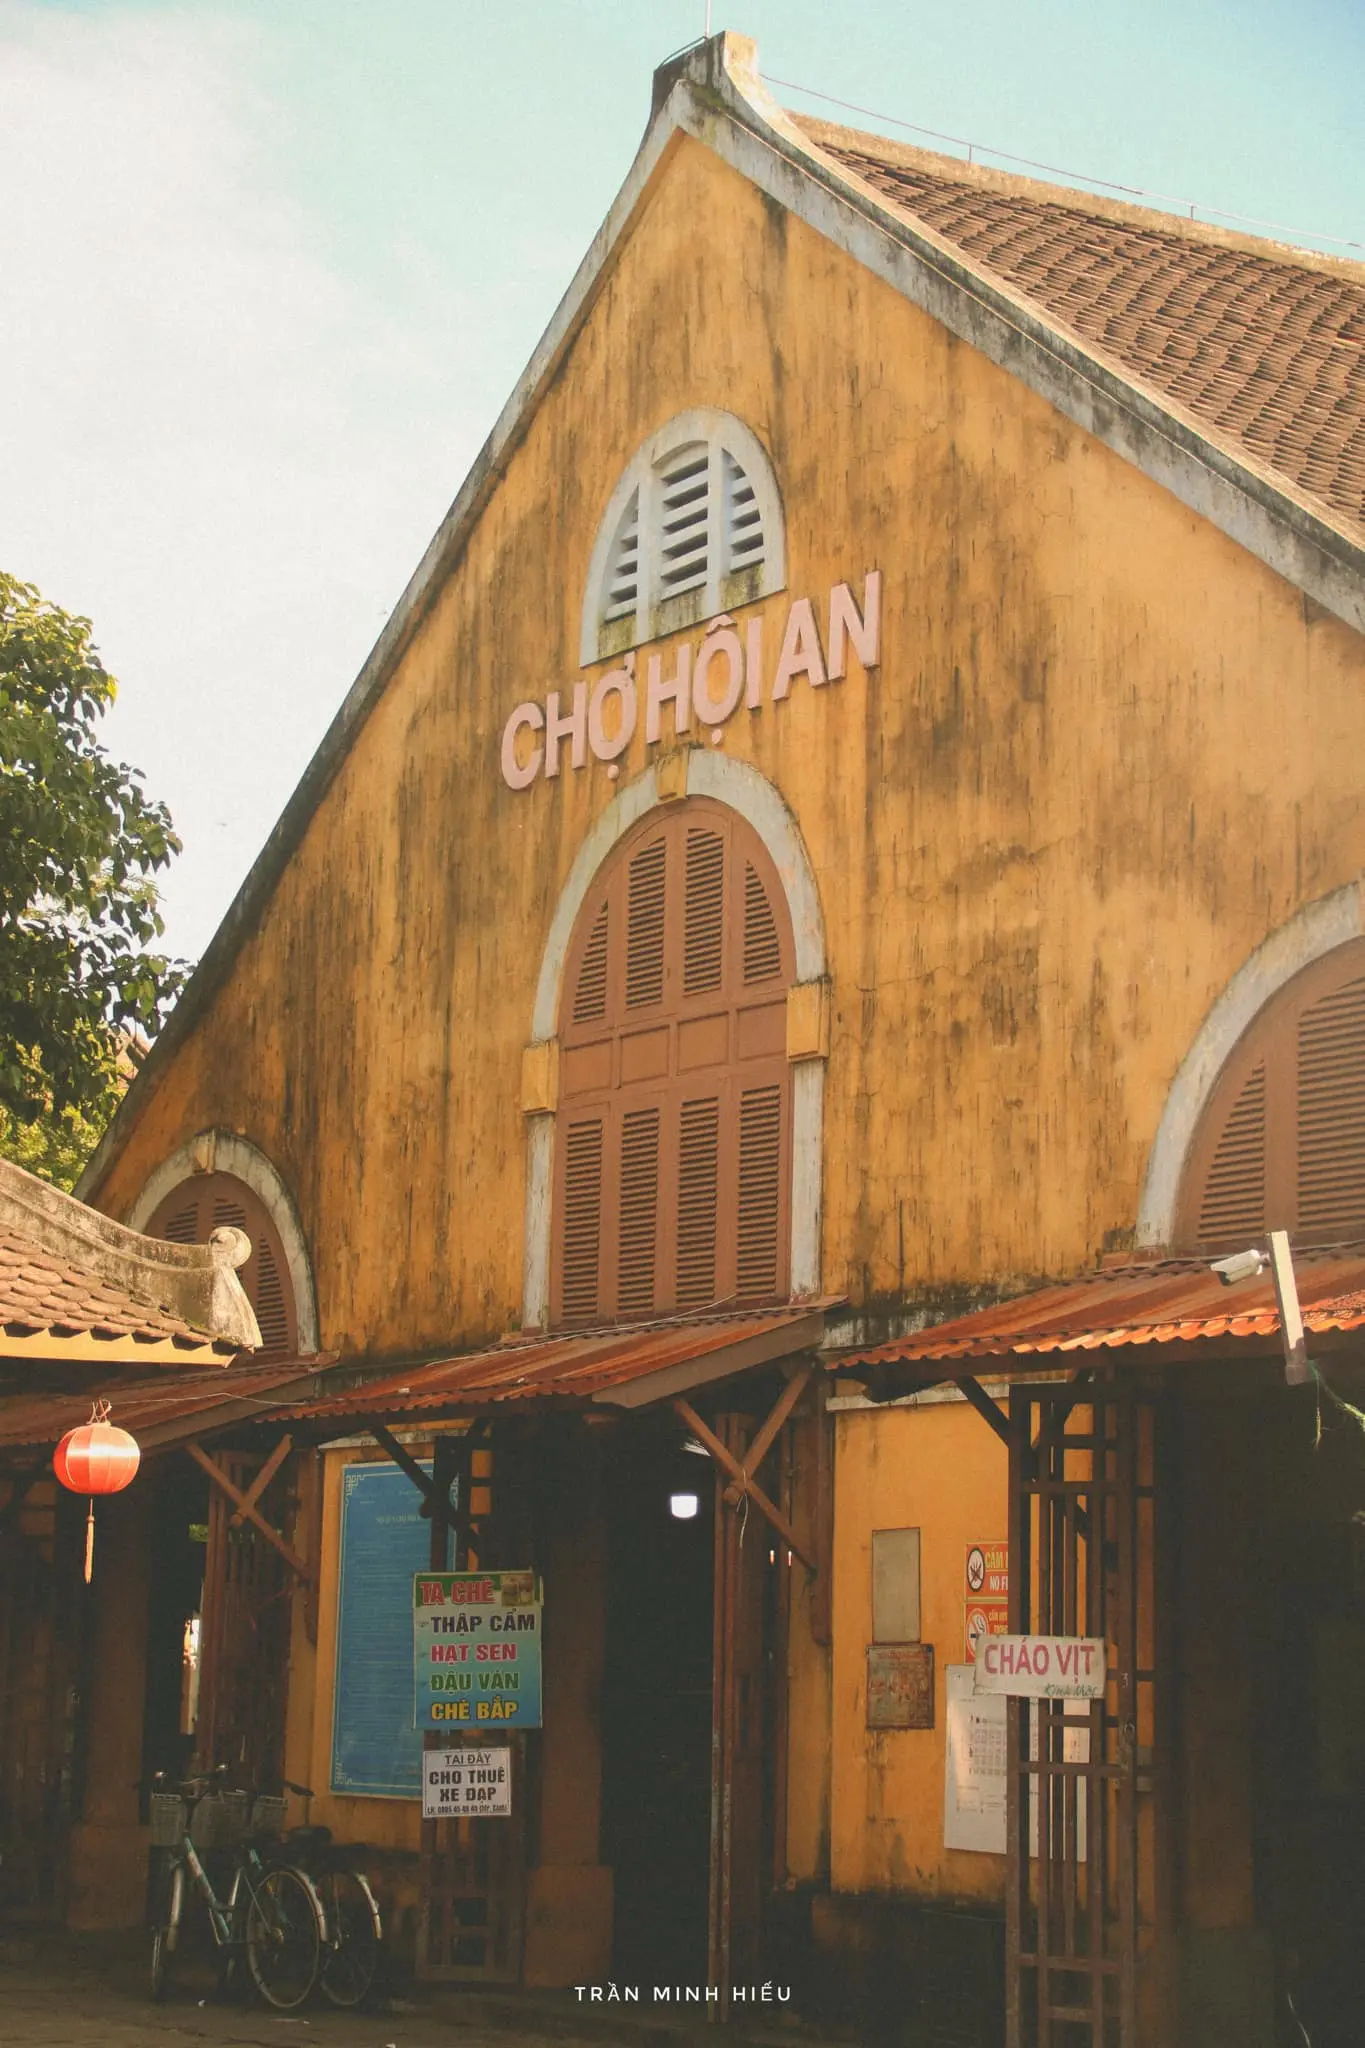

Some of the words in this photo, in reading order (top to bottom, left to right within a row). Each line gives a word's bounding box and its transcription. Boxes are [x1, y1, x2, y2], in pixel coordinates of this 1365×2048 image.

[501, 651, 637, 790] CHỢ
[646, 614, 763, 745] HỘI
[771, 569, 882, 702] AN
[430, 1612, 482, 1636] THẬP
[490, 1608, 536, 1632] CẨM
[431, 1643, 470, 1665] HẠT
[475, 1642, 518, 1662] SEN
[984, 1637, 1050, 1676] CHÁO
[1055, 1644, 1096, 1683] VỊT
[430, 1670, 472, 1694] ĐẬU
[476, 1695, 519, 1721] BẮP
[429, 1770, 462, 1785] CHO
[468, 1766, 505, 1784] THUÊ
[440, 1788, 460, 1802] XE
